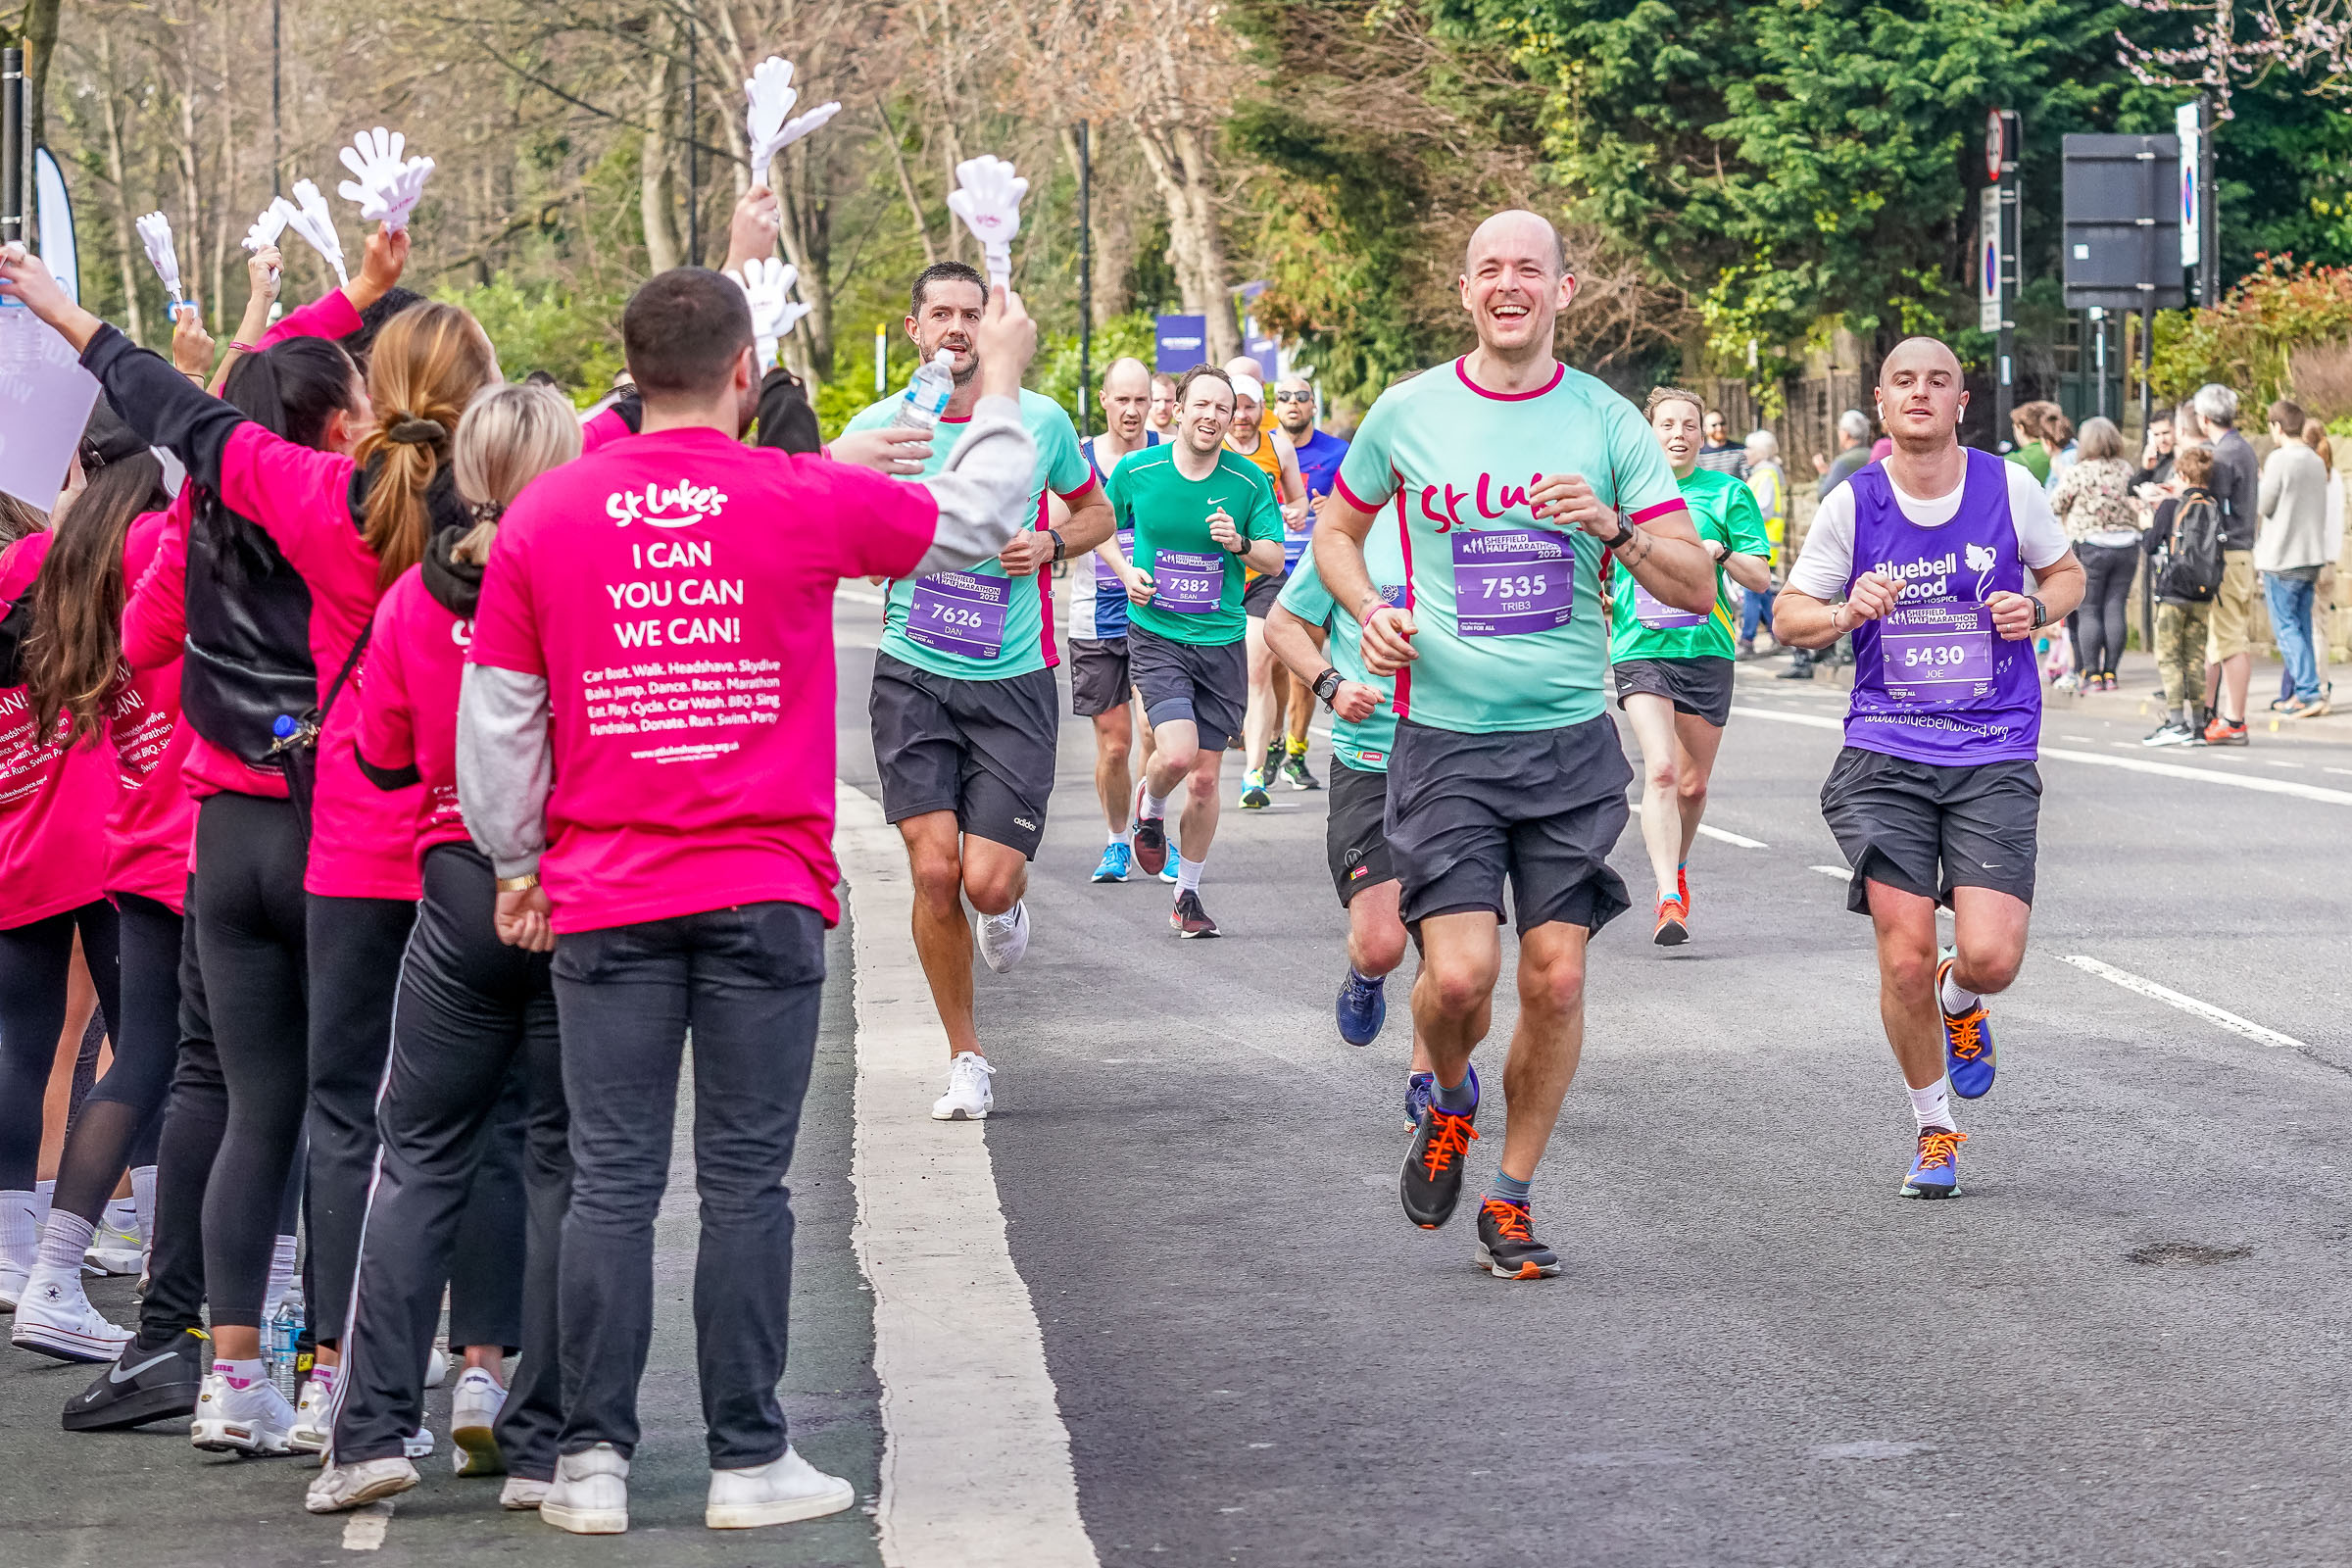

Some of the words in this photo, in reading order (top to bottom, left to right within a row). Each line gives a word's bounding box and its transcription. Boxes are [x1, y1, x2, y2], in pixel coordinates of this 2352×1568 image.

[606, 490, 644, 527] St
[646, 478, 728, 516] Luke's
[1421, 483, 1469, 534] St
[1486, 535, 1528, 545] SHEFFIELD
[632, 543, 642, 569] I
[647, 541, 711, 568] CAN
[1486, 544, 1508, 553] HALF
[1538, 550, 1562, 559] 2022
[1875, 553, 1957, 580] Bluebell
[942, 571, 975, 584] SHEFFIELD
[1169, 577, 1209, 592] 7382
[942, 578, 958, 587] HALF
[958, 583, 1001, 595] MARATHON
[1457, 585, 1465, 594] L
[1482, 574, 1547, 599] 7535
[606, 580, 672, 610] YOU
[678, 579, 744, 606] CAN
[979, 593, 1000, 602] 2022
[1924, 595, 1958, 605] HOSPICE
[1500, 600, 1531, 612] TRIB3
[1907, 609, 1945, 617] SHEFFIELD
[930, 603, 982, 628] 7626
[1929, 613, 1978, 624] MARATHON
[613, 619, 662, 649] WE
[667, 617, 741, 646] CAN!
[944, 626, 962, 635] DAN
[1884, 654, 1890, 662] S
[1904, 645, 1965, 667] 5430
[582, 670, 604, 683] Car
[667, 660, 737, 675] Headshave.
[738, 659, 781, 675] Skydive
[1925, 669, 1945, 678] JOE
[648, 681, 691, 695] Dance.
[726, 676, 781, 690] Marathon
[667, 698, 690, 711] Car
[755, 693, 781, 710] Sing
[640, 717, 688, 732] Donate.
[750, 710, 780, 725] Party
[1013, 817, 1037, 832] adidas
